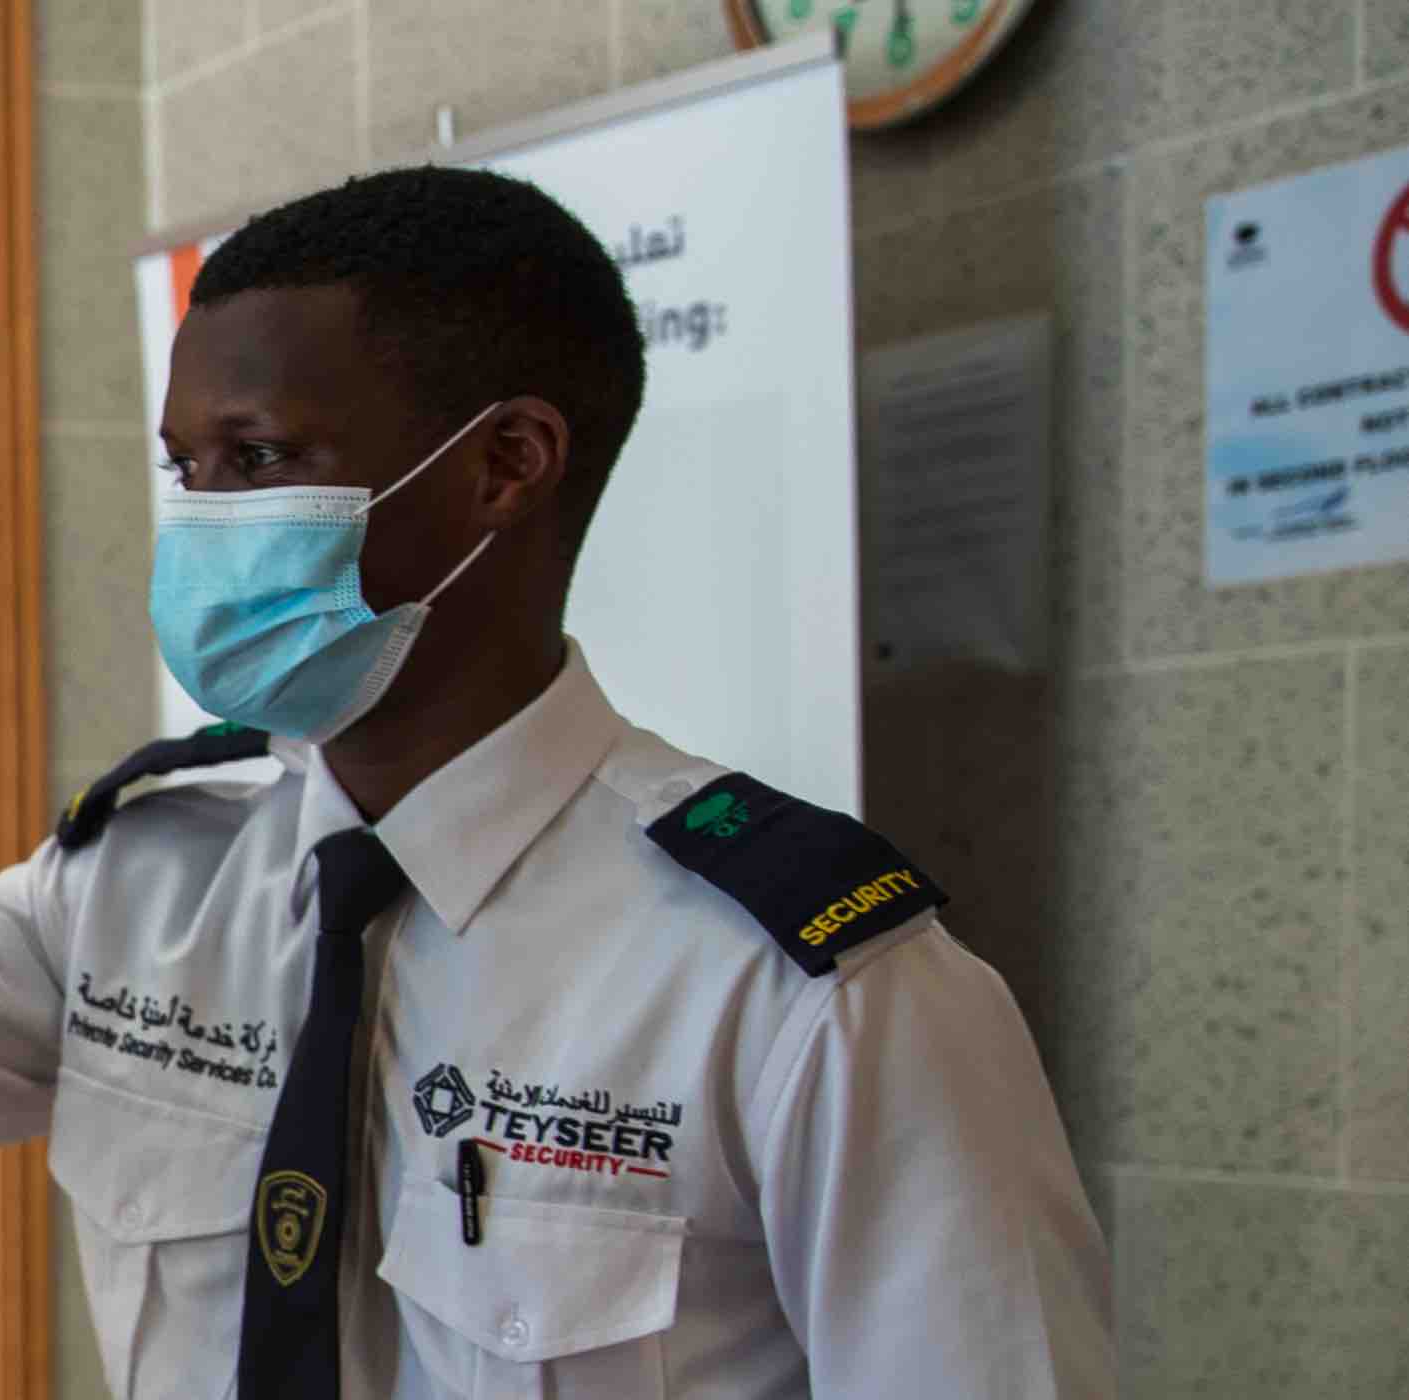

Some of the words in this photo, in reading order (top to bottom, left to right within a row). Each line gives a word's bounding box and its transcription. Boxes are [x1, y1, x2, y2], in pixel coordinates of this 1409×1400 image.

[638, 300, 727, 352] ing:
[1353, 445, 1409, 476] FLOO
[798, 868, 920, 946] SECURITY
[119, 1032, 175, 1070] Security
[177, 1048, 253, 1086] Services
[480, 1099, 673, 1161] TEYSEER
[509, 1141, 625, 1176] SECURITY
